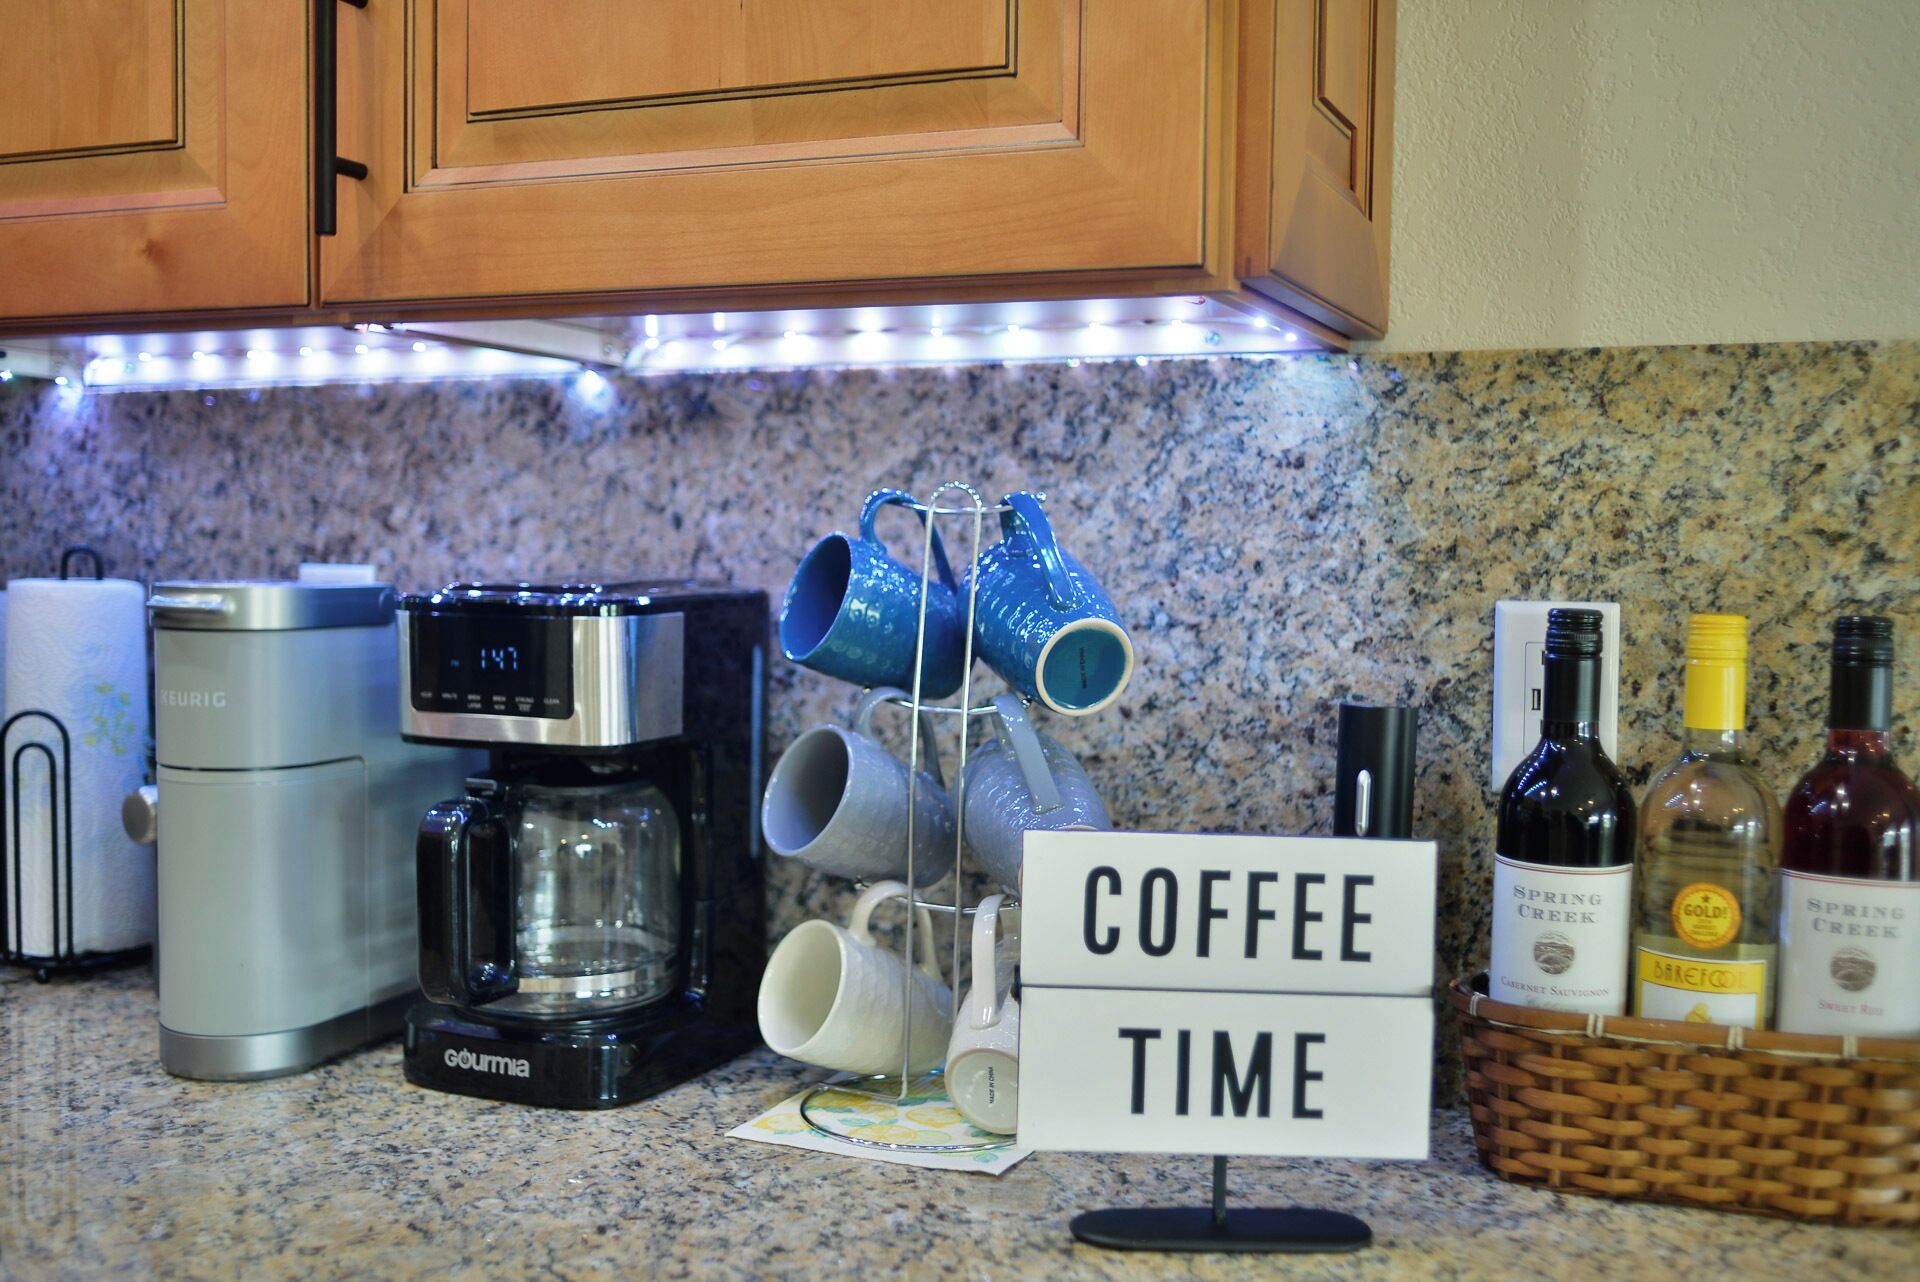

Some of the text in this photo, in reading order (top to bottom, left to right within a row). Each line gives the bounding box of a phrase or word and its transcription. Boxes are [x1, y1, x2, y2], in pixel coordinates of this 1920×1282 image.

[160, 689, 226, 708] KEURIG
[1513, 884, 1602, 906] SPRING
[1083, 865, 1375, 963] COFFEE
[1518, 904, 1597, 924] CREEK
[1683, 903, 1729, 920] GOLD!
[1807, 897, 1905, 920] SPRING
[1813, 917, 1898, 939] CREEK
[1500, 975, 1610, 998] CABERNET SAUVIGNON
[443, 1047, 530, 1078] Gourmia
[1118, 1027, 1326, 1120] TIME
